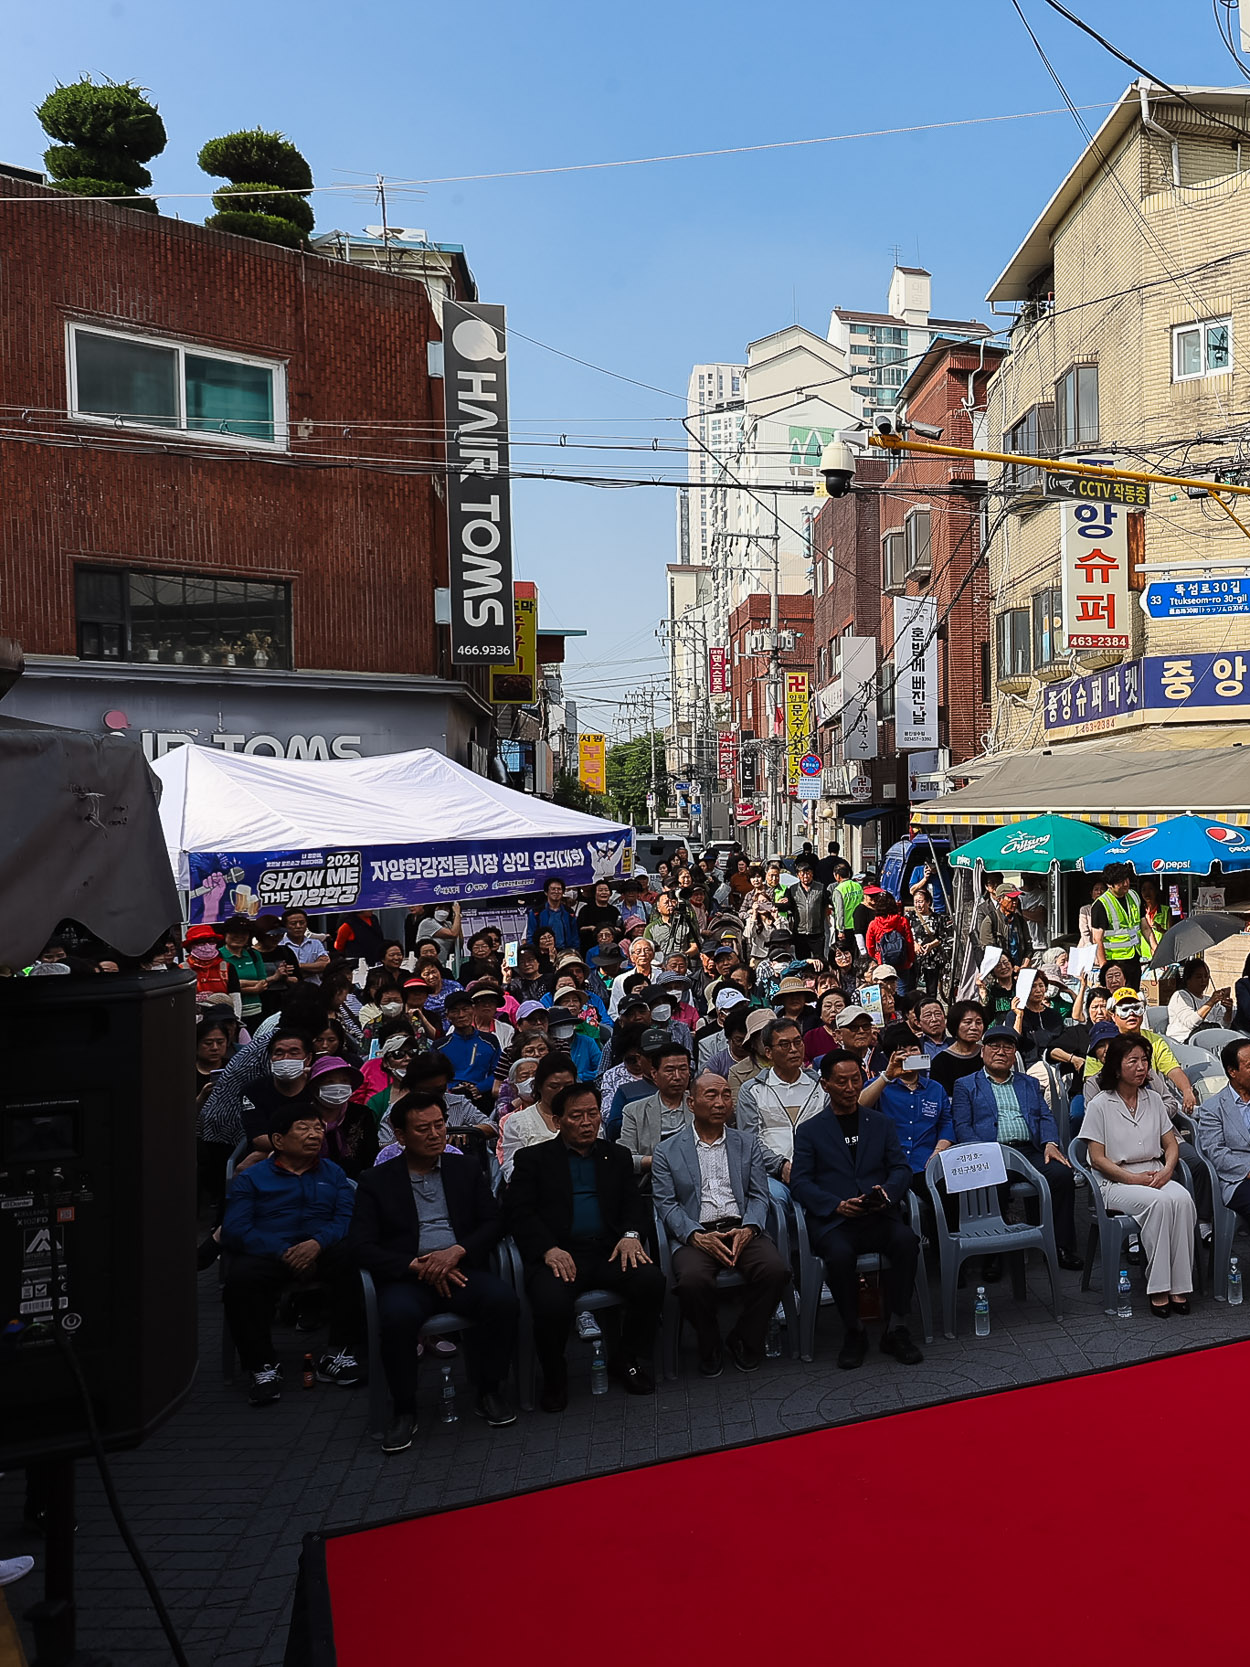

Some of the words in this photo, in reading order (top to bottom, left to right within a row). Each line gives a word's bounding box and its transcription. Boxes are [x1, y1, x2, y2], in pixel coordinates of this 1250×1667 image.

[457, 370, 499, 482] HAIR
[1079, 480, 1112, 497] CCTV
[1114, 485, 1147, 504] 작동중
[1074, 459, 1119, 629] 앙슈퍼
[460, 495, 504, 627] TOMS
[1150, 596, 1162, 605] 33
[1169, 595, 1222, 606] Ttukseom-ro
[1223, 594, 1248, 604] 30-gil
[457, 644, 511, 657] 466.9336
[1070, 635, 1127, 648] 463-2384
[911, 676, 926, 705] 빠진
[1047, 665, 1138, 723] 중앙슈퍼마켓
[912, 710, 927, 726] 날
[582, 745, 601, 789] 부동산
[326, 854, 359, 868] 2024
[370, 854, 498, 882] 자양한강전통시장
[502, 851, 530, 873] 상인
[533, 848, 585, 870] 요리대회
[1165, 859, 1191, 870] pepsi
[260, 869, 325, 891] SHOW
[326, 867, 359, 887] ME
[261, 892, 290, 904] THE
[286, 885, 359, 908] 자양한강
